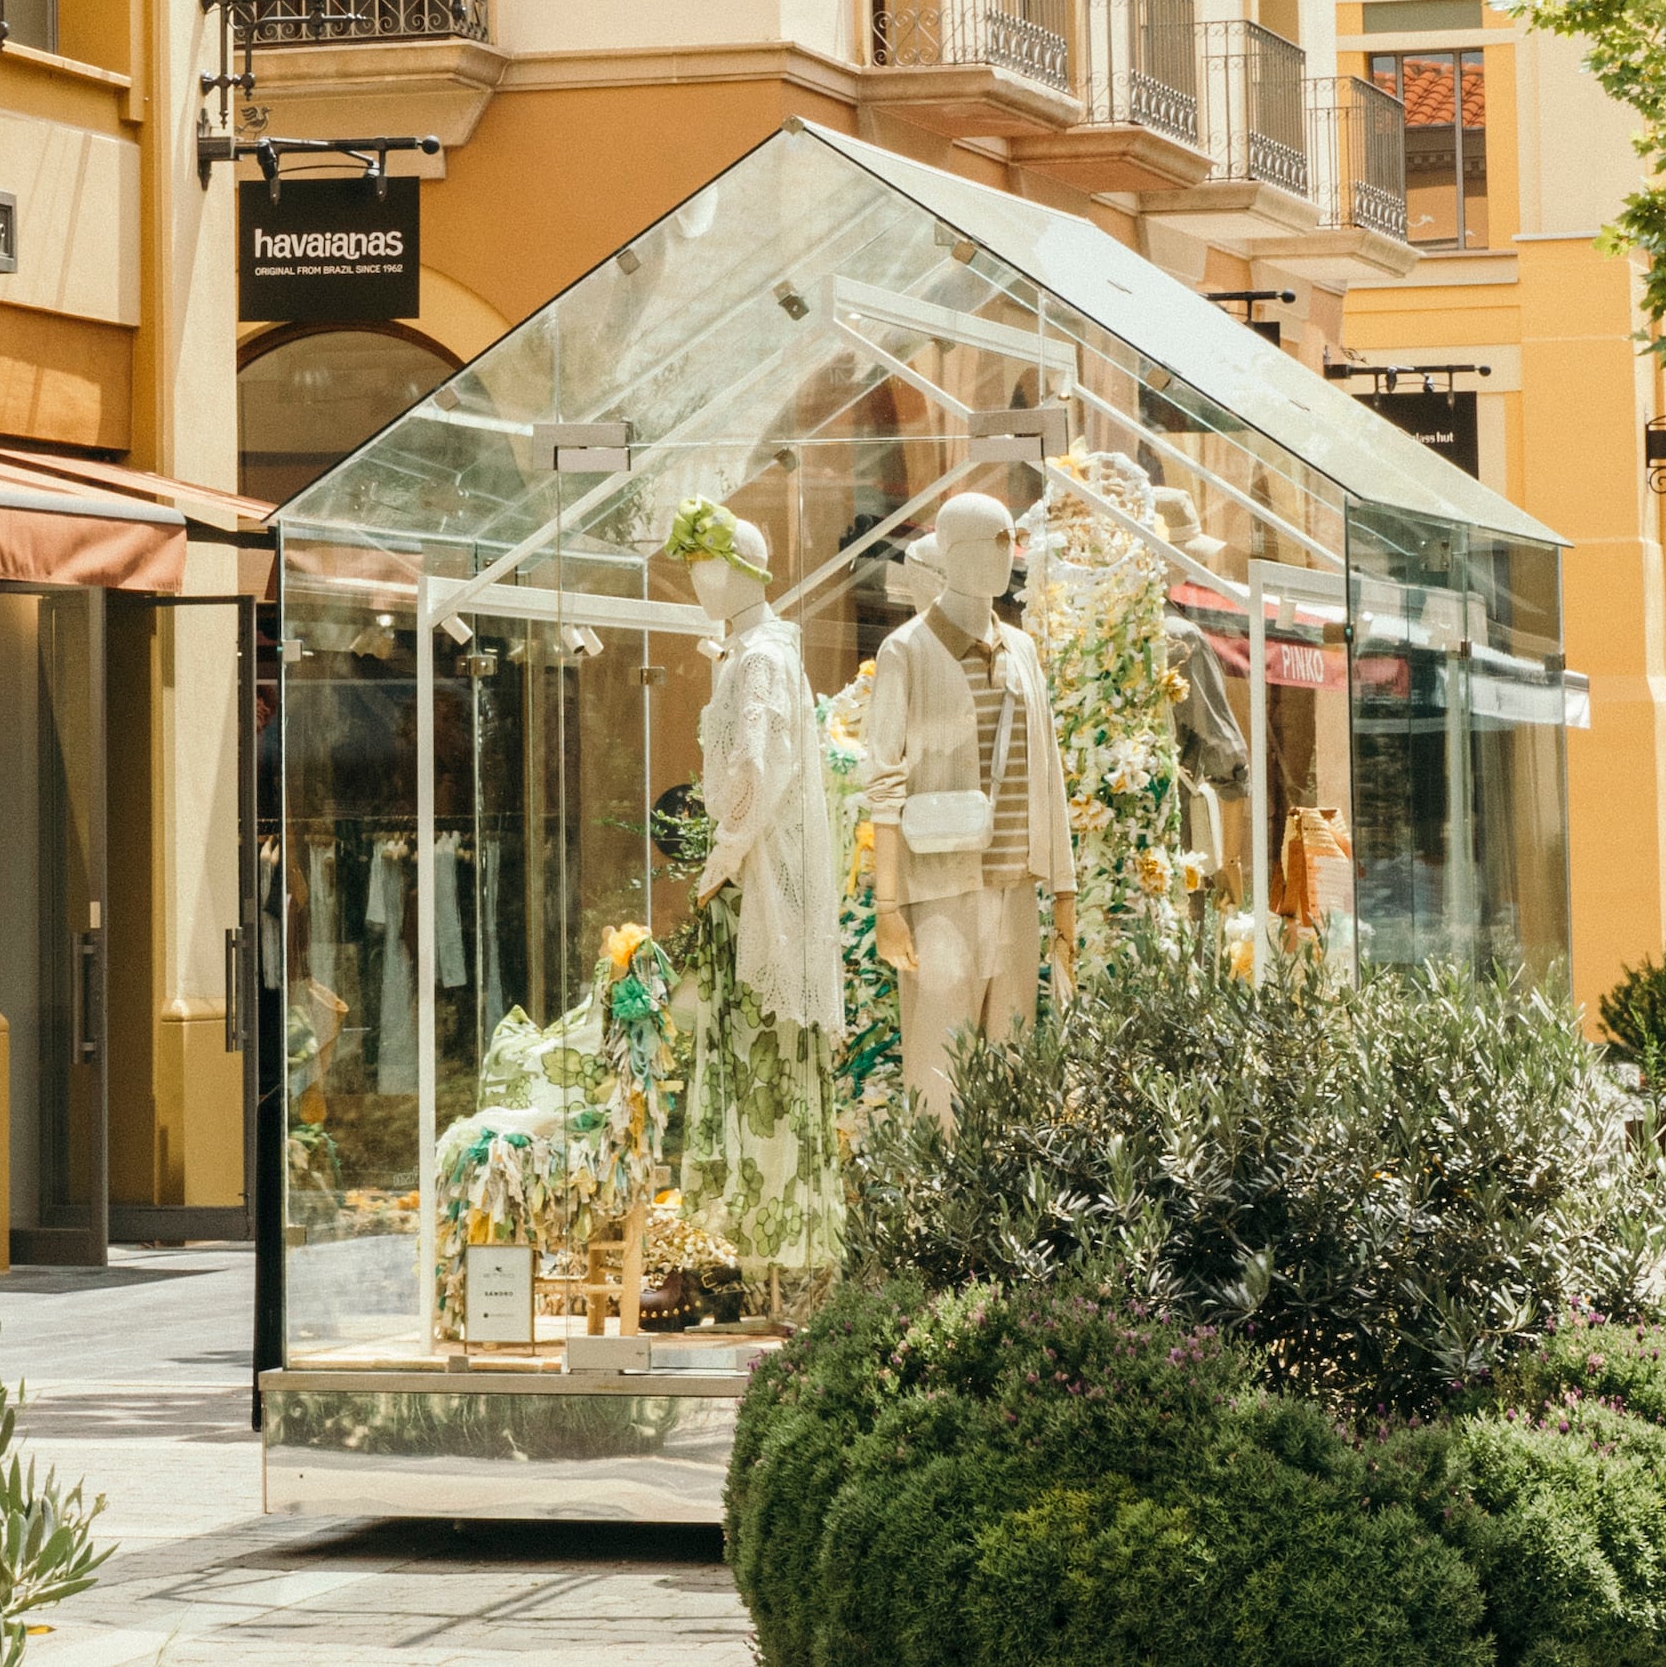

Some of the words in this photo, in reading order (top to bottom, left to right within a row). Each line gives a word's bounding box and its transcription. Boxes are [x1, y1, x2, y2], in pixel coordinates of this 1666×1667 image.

[254, 227, 404, 260] havaianas
[254, 266, 296, 276] ORIGINAL
[297, 266, 322, 276] FROM
[323, 265, 354, 275] BRAZIL
[355, 264, 381, 274] SINCE
[383, 263, 403, 273] 1962
[1436, 431, 1454, 443] hut
[1280, 644, 1325, 683] PINKO
